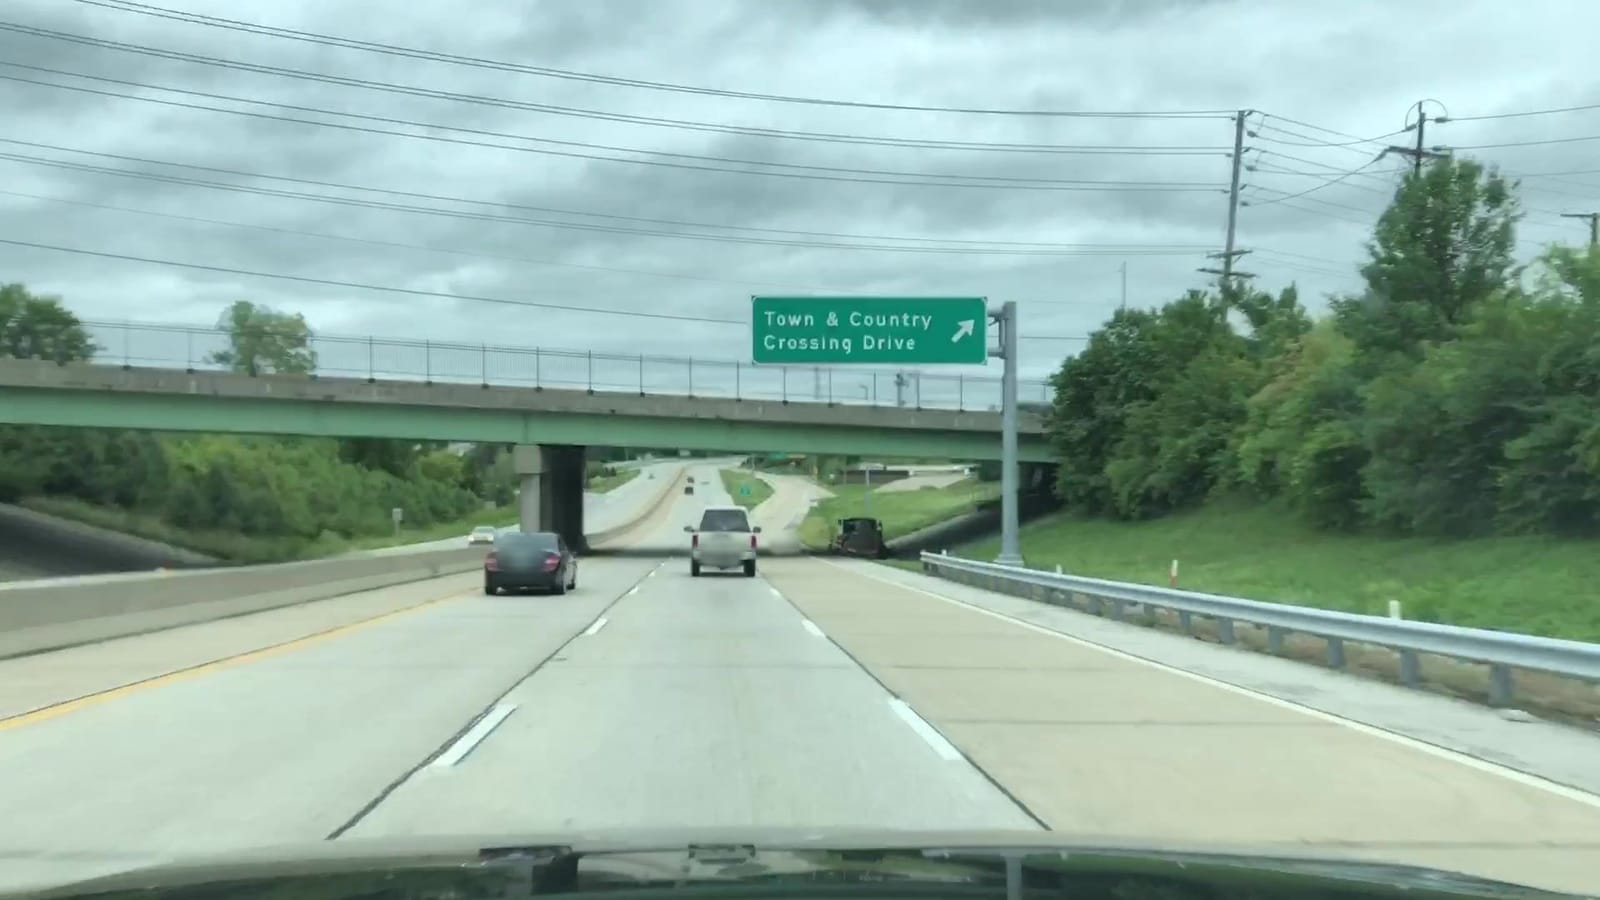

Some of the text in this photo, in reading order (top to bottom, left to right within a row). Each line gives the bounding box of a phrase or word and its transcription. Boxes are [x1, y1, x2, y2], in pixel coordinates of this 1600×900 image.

[764, 311, 932, 330] Town & Country
[764, 335, 916, 354] Crossing Drive
